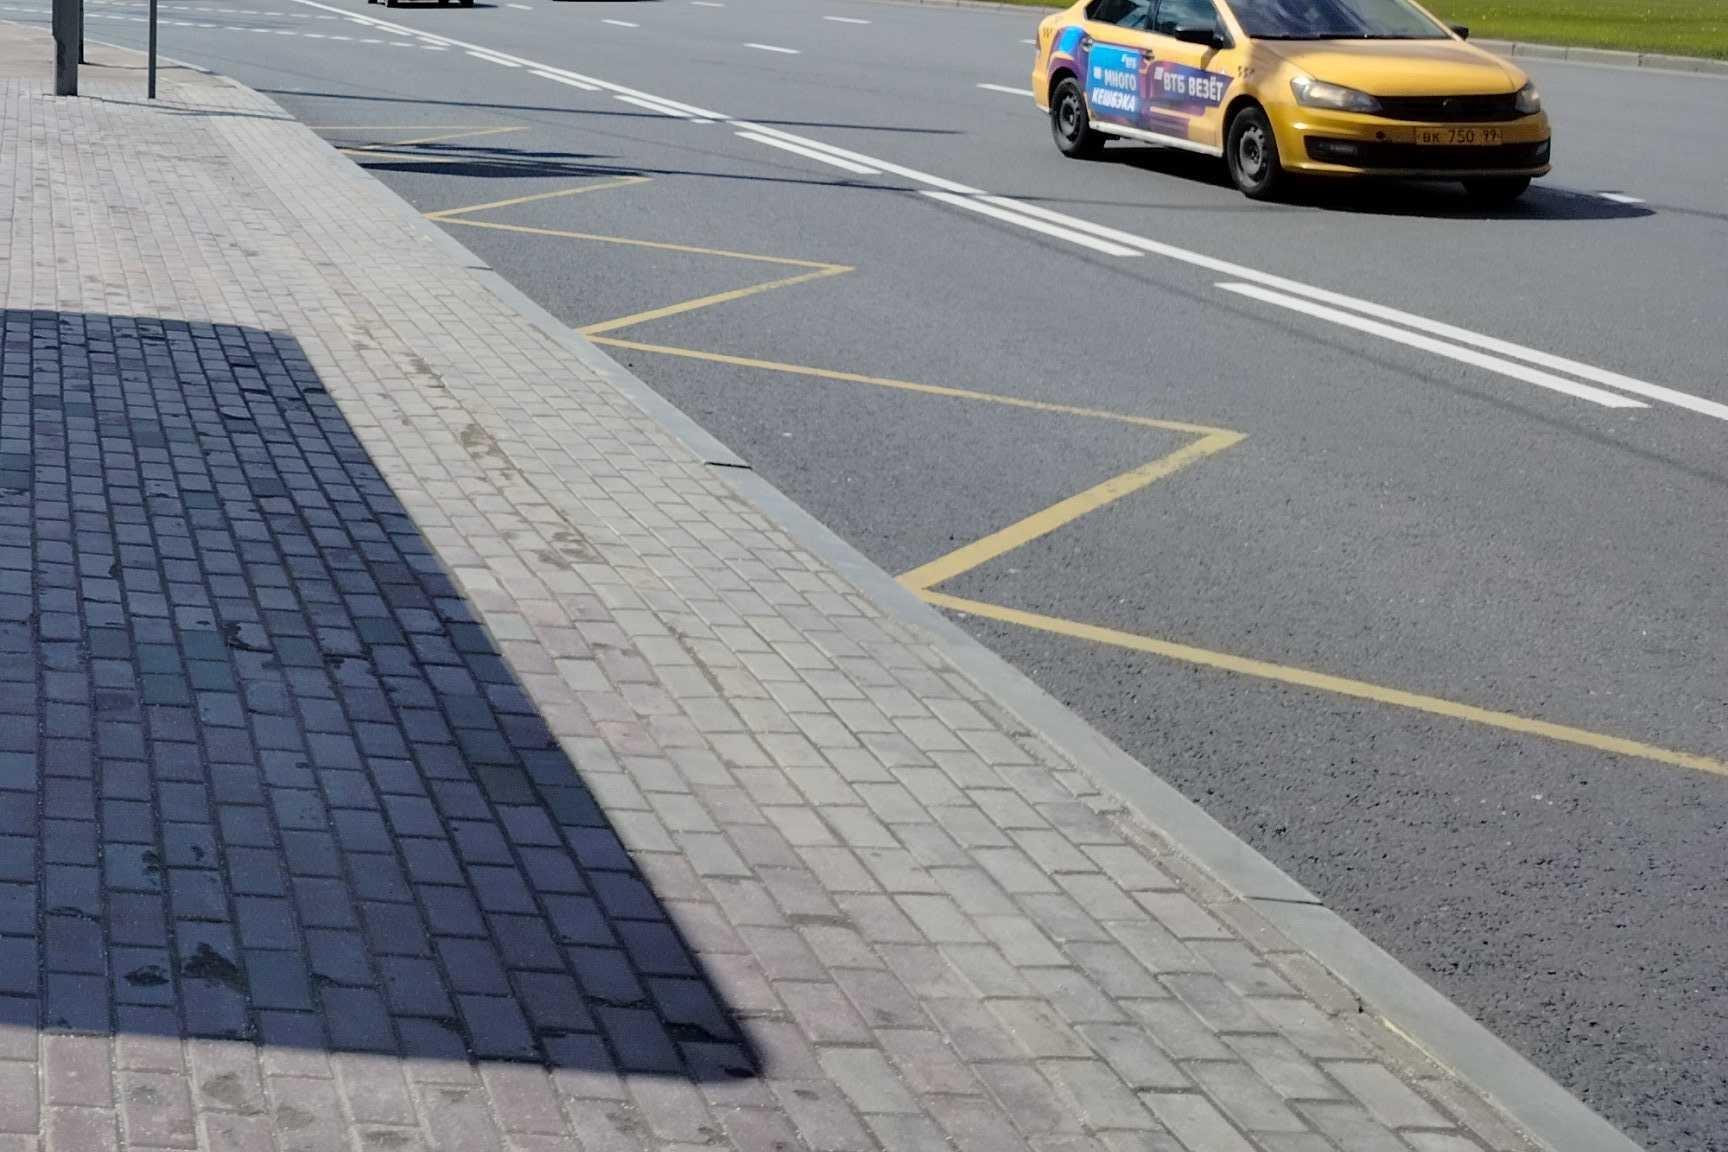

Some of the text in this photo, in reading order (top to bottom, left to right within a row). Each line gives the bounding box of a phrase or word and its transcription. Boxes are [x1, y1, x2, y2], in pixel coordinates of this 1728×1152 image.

[1104, 68, 1137, 91] МНОГО
[1163, 72, 1224, 102] ВТБ ВЕЗЁТ
